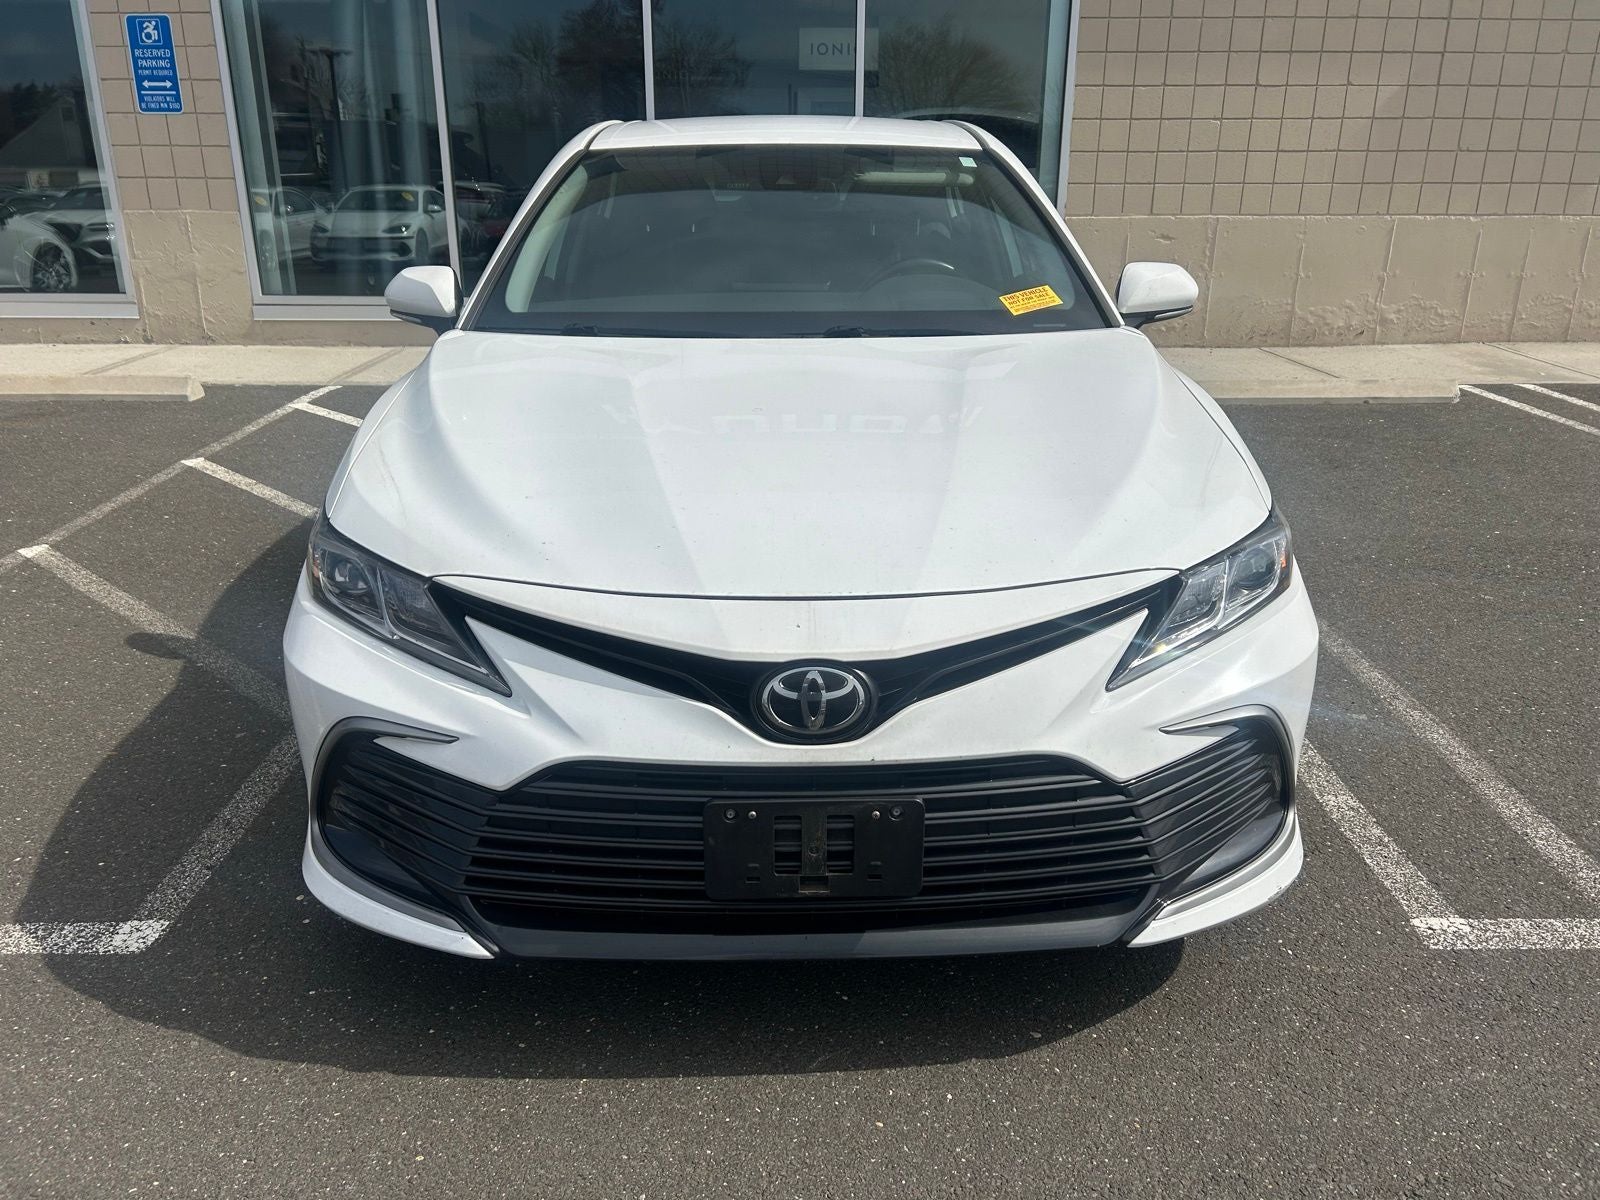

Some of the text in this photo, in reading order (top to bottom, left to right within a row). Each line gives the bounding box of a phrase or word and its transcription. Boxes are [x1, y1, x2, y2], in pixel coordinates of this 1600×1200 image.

[134, 49, 171, 57] RESERVED
[810, 42, 856, 56] IONI
[138, 59, 171, 68] PARKING
[1003, 288, 1048, 302] THIS VEHICLE
